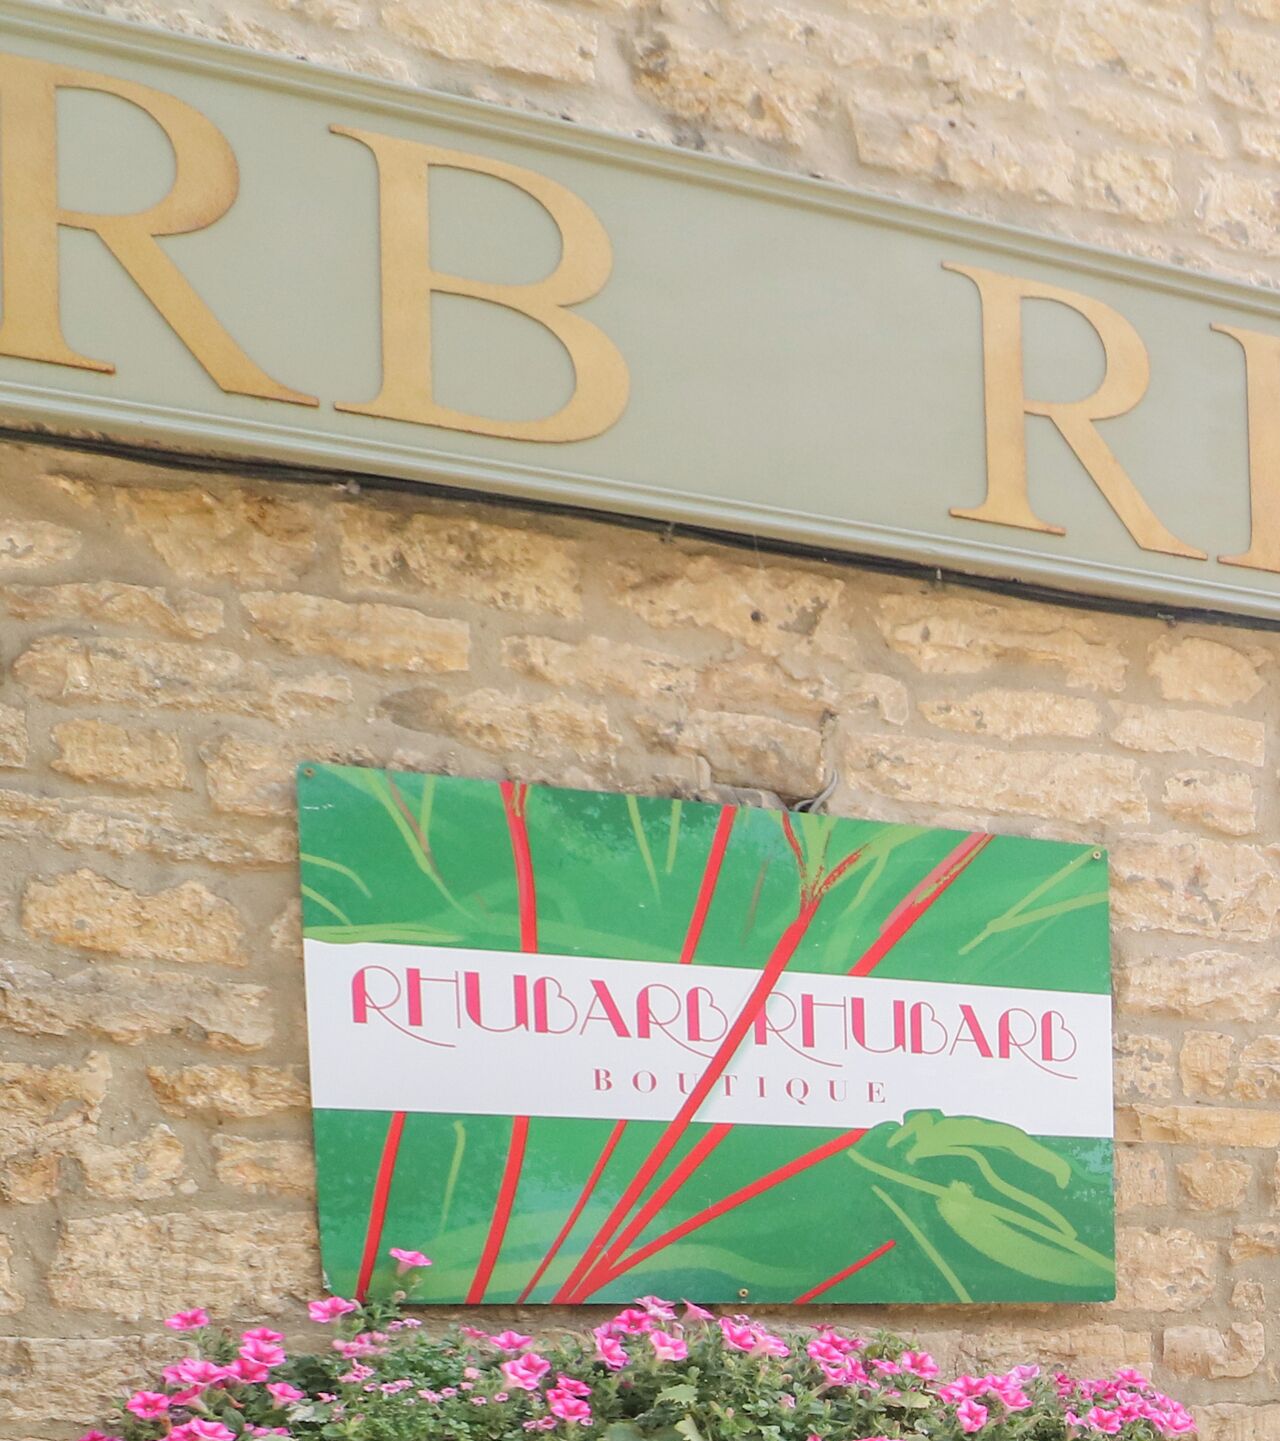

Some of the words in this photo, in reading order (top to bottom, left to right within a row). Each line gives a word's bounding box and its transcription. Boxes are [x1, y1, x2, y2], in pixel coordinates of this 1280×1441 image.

[0, 53, 631, 443] RB
[351, 964, 728, 1059] RHUBARB
[754, 991, 1078, 1079] RHUBARB
[592, 1067, 887, 1105] BOUTIQUE
